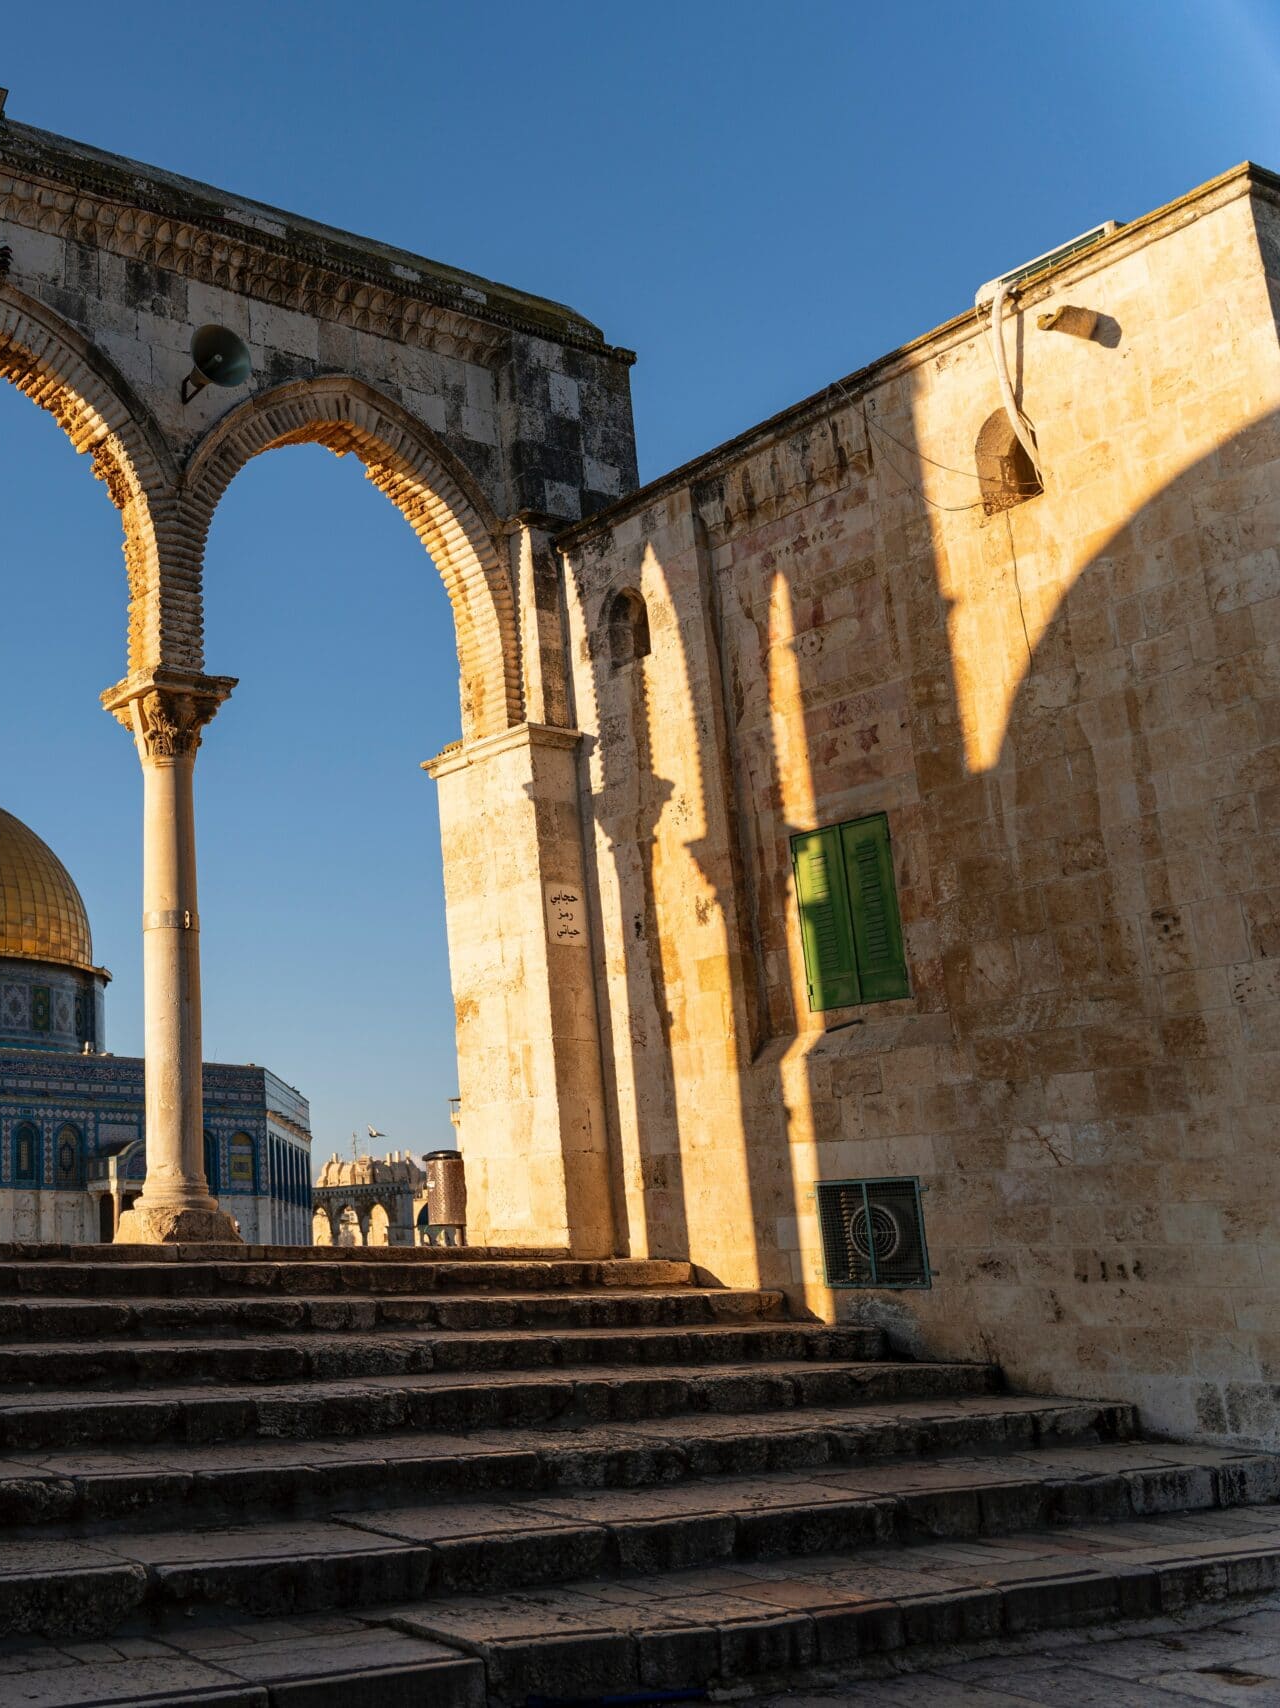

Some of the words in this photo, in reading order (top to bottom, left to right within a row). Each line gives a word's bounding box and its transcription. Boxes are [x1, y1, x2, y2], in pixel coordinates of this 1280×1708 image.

[550, 889, 579, 906] حجابي
[557, 908, 574, 921] رمز
[556, 924, 581, 939] حياتي
